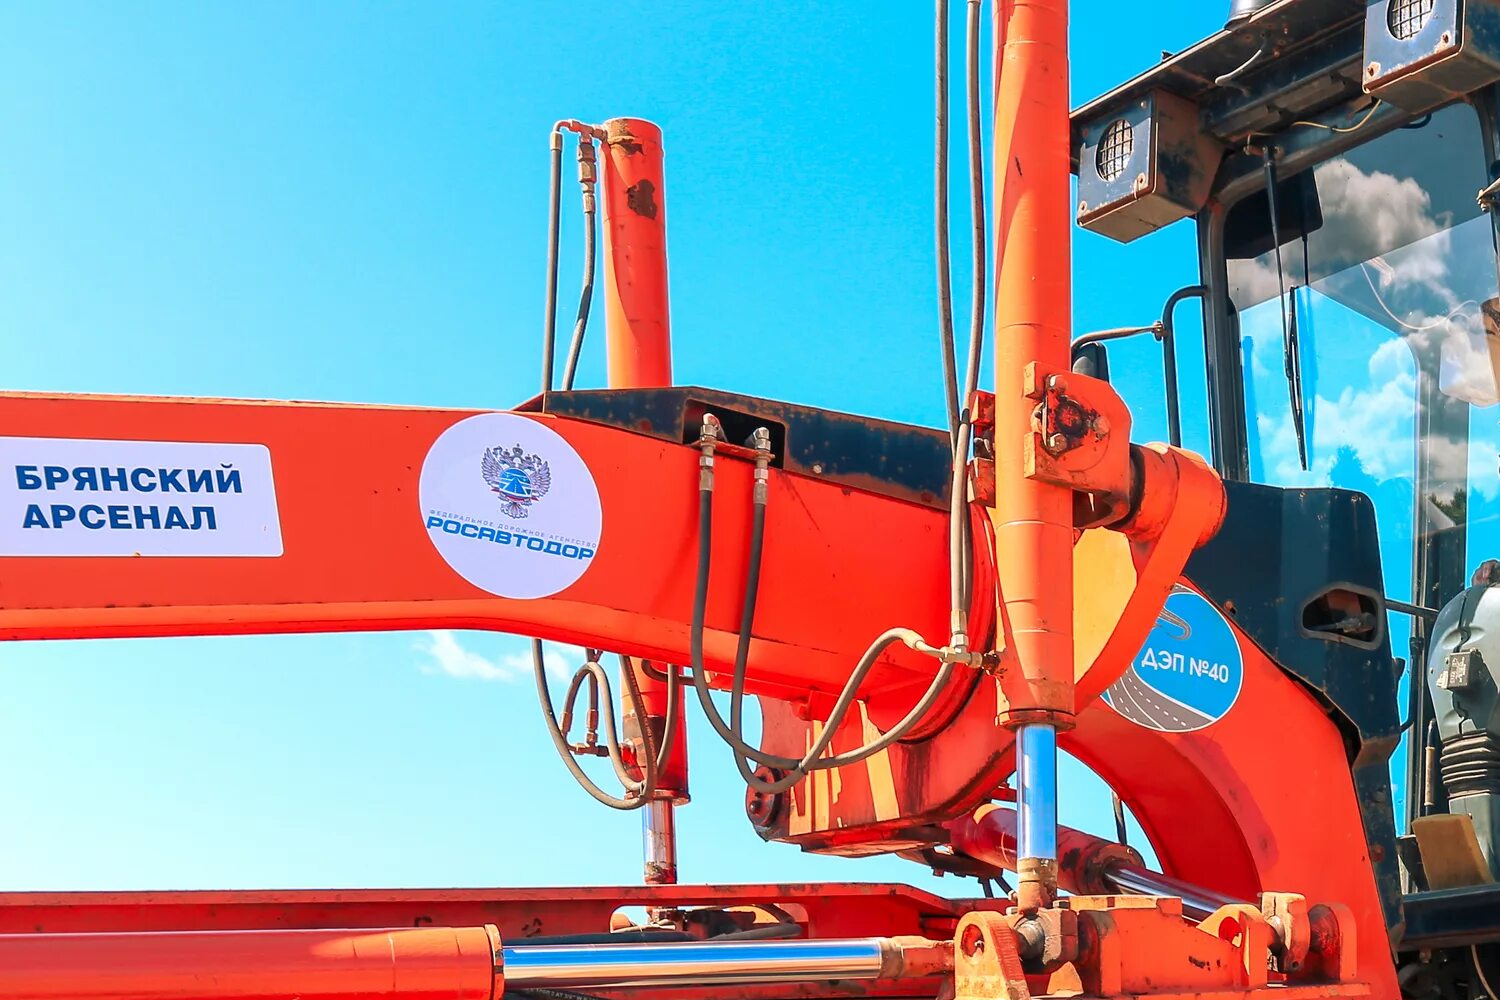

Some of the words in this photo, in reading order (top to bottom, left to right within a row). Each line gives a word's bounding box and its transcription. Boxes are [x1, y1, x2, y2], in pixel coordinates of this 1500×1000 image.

[15, 463, 243, 494] БРЯНСКИЙ
[22, 504, 218, 530] АРСЕНАЛ
[429, 509, 494, 527] ФЕДЕРАЛЬНОЕ
[498, 523, 545, 538] ДОРОЖНОЕ
[548, 534, 598, 549] АГЕНТСТВО
[426, 515, 595, 561] РОСАВТОДОР
[1141, 647, 1185, 673] ДЭП
[1189, 656, 1229, 684] №40
